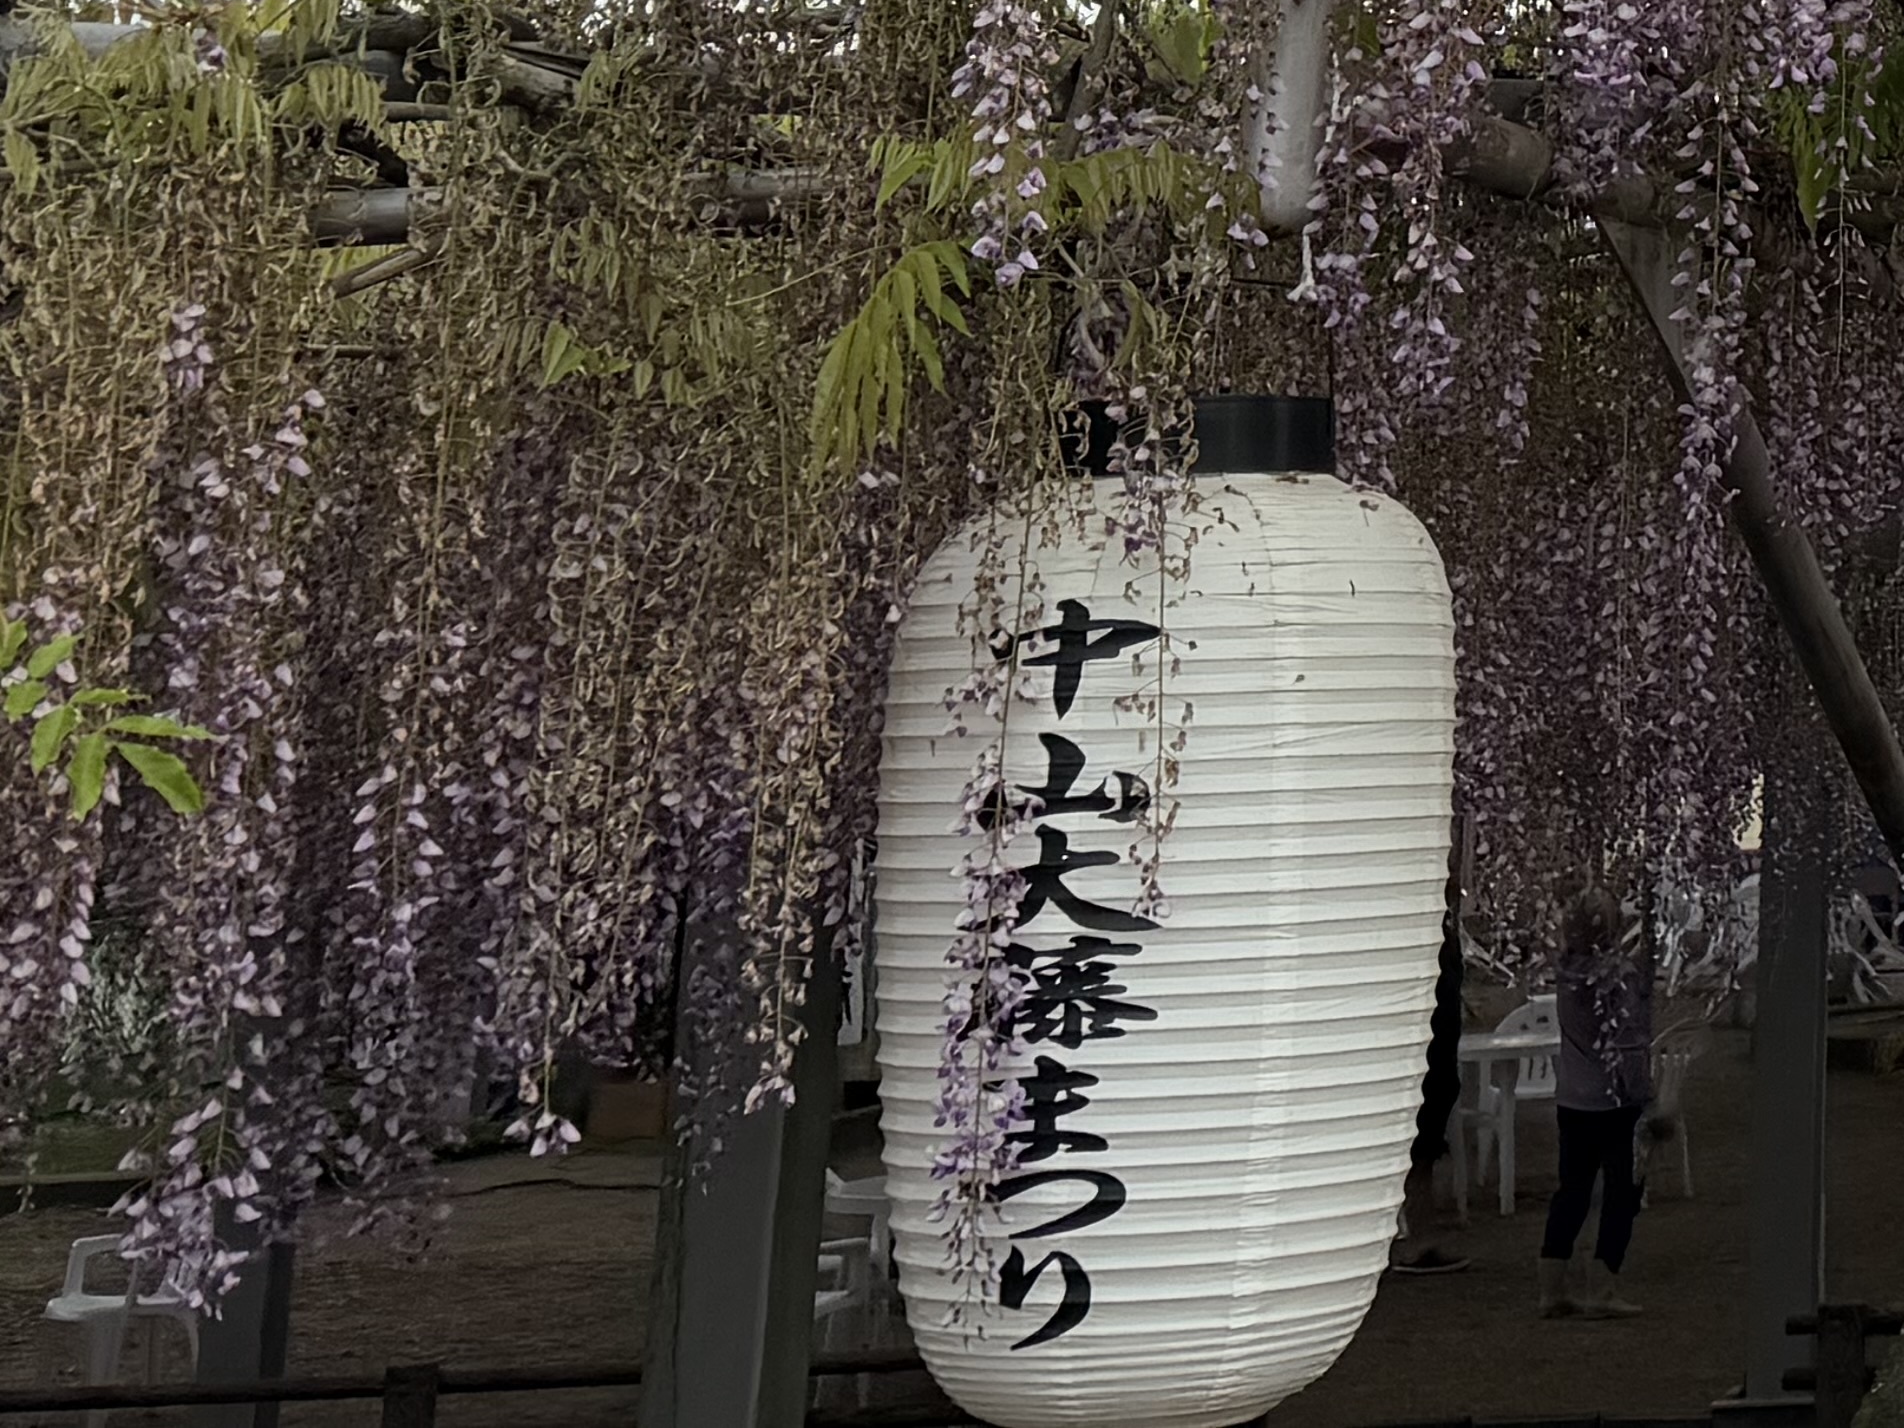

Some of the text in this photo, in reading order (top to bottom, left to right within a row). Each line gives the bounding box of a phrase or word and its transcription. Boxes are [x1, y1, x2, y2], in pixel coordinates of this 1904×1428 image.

[957, 598, 1163, 1351] 中山大藤まつり
